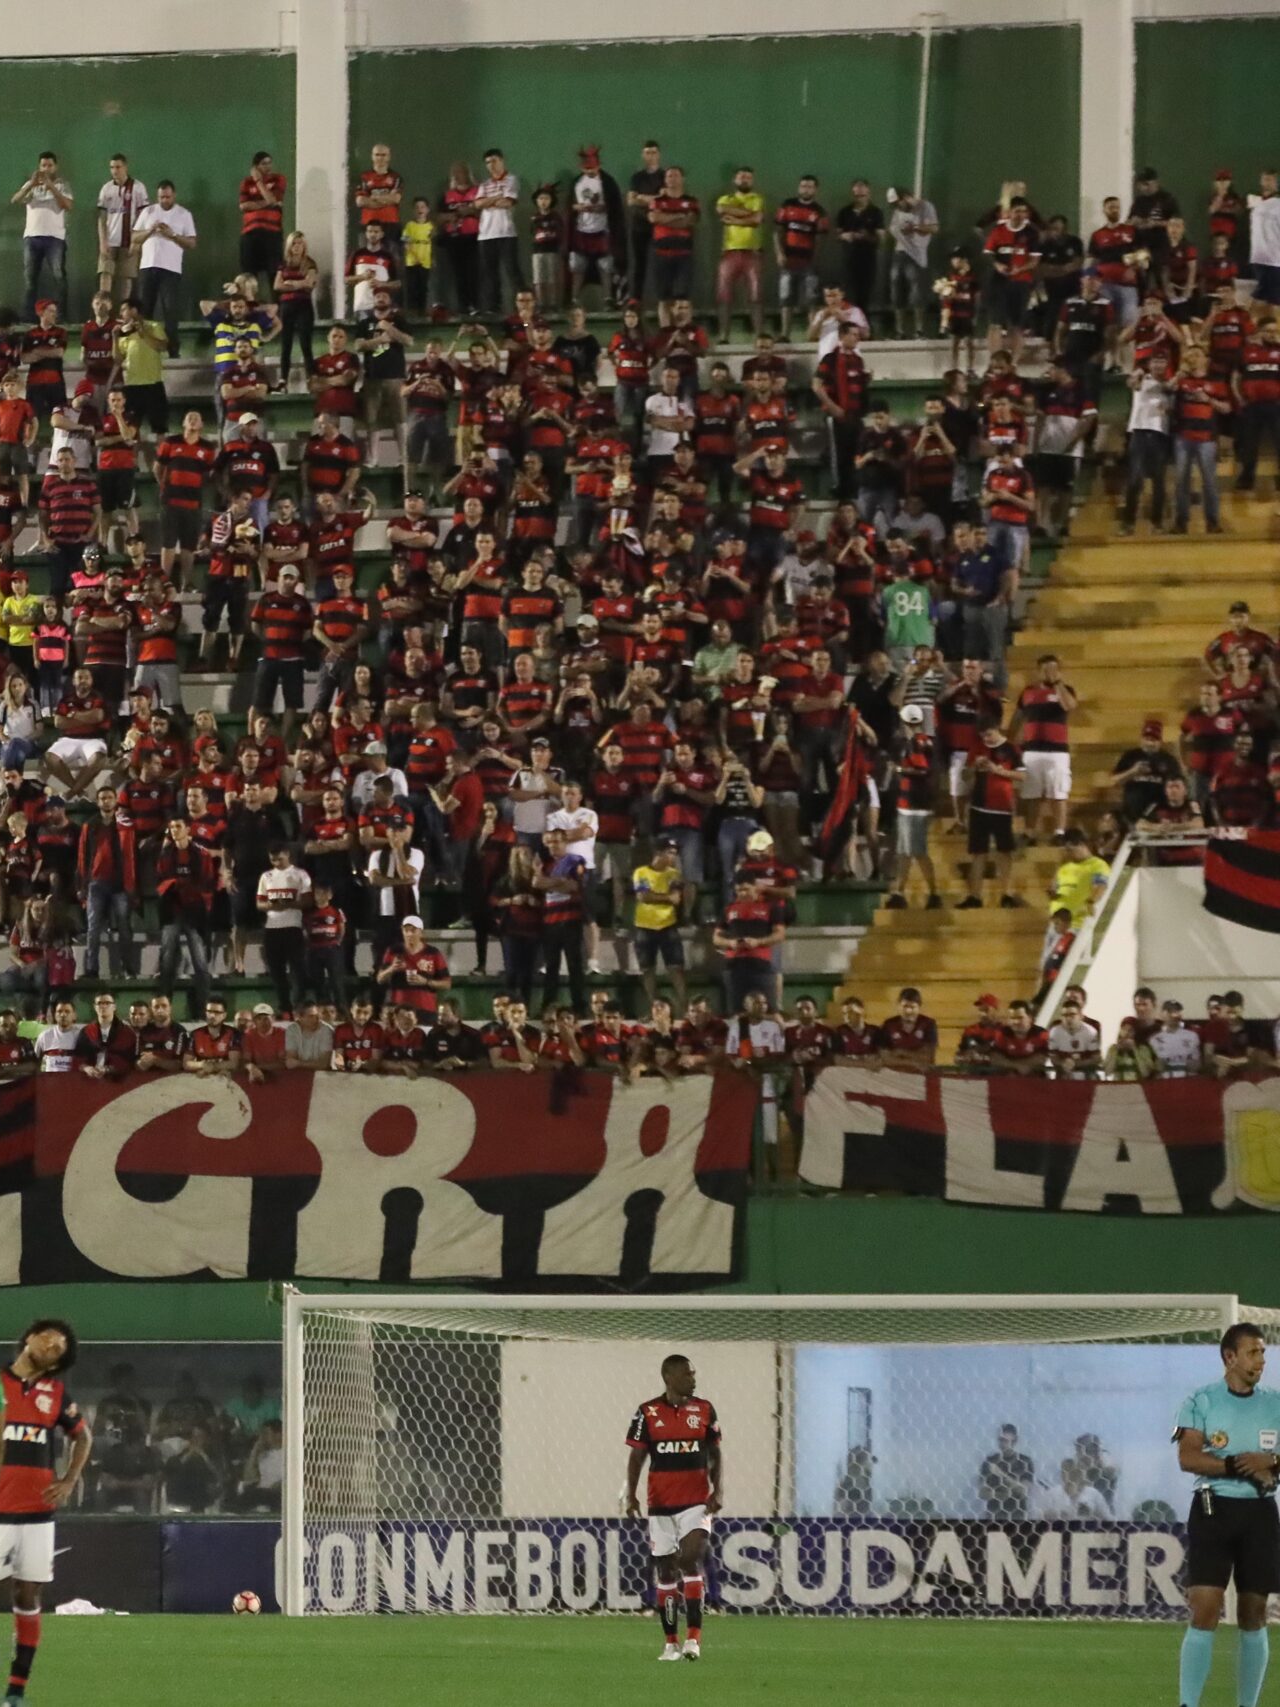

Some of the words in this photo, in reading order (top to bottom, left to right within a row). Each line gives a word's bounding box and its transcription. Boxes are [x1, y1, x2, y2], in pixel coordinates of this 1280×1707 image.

[893, 591, 924, 617] 84
[2, 1424, 48, 1444] AIXA
[656, 1441, 700, 1454] CAIXA
[720, 1530, 1187, 1608] SUDAMER
